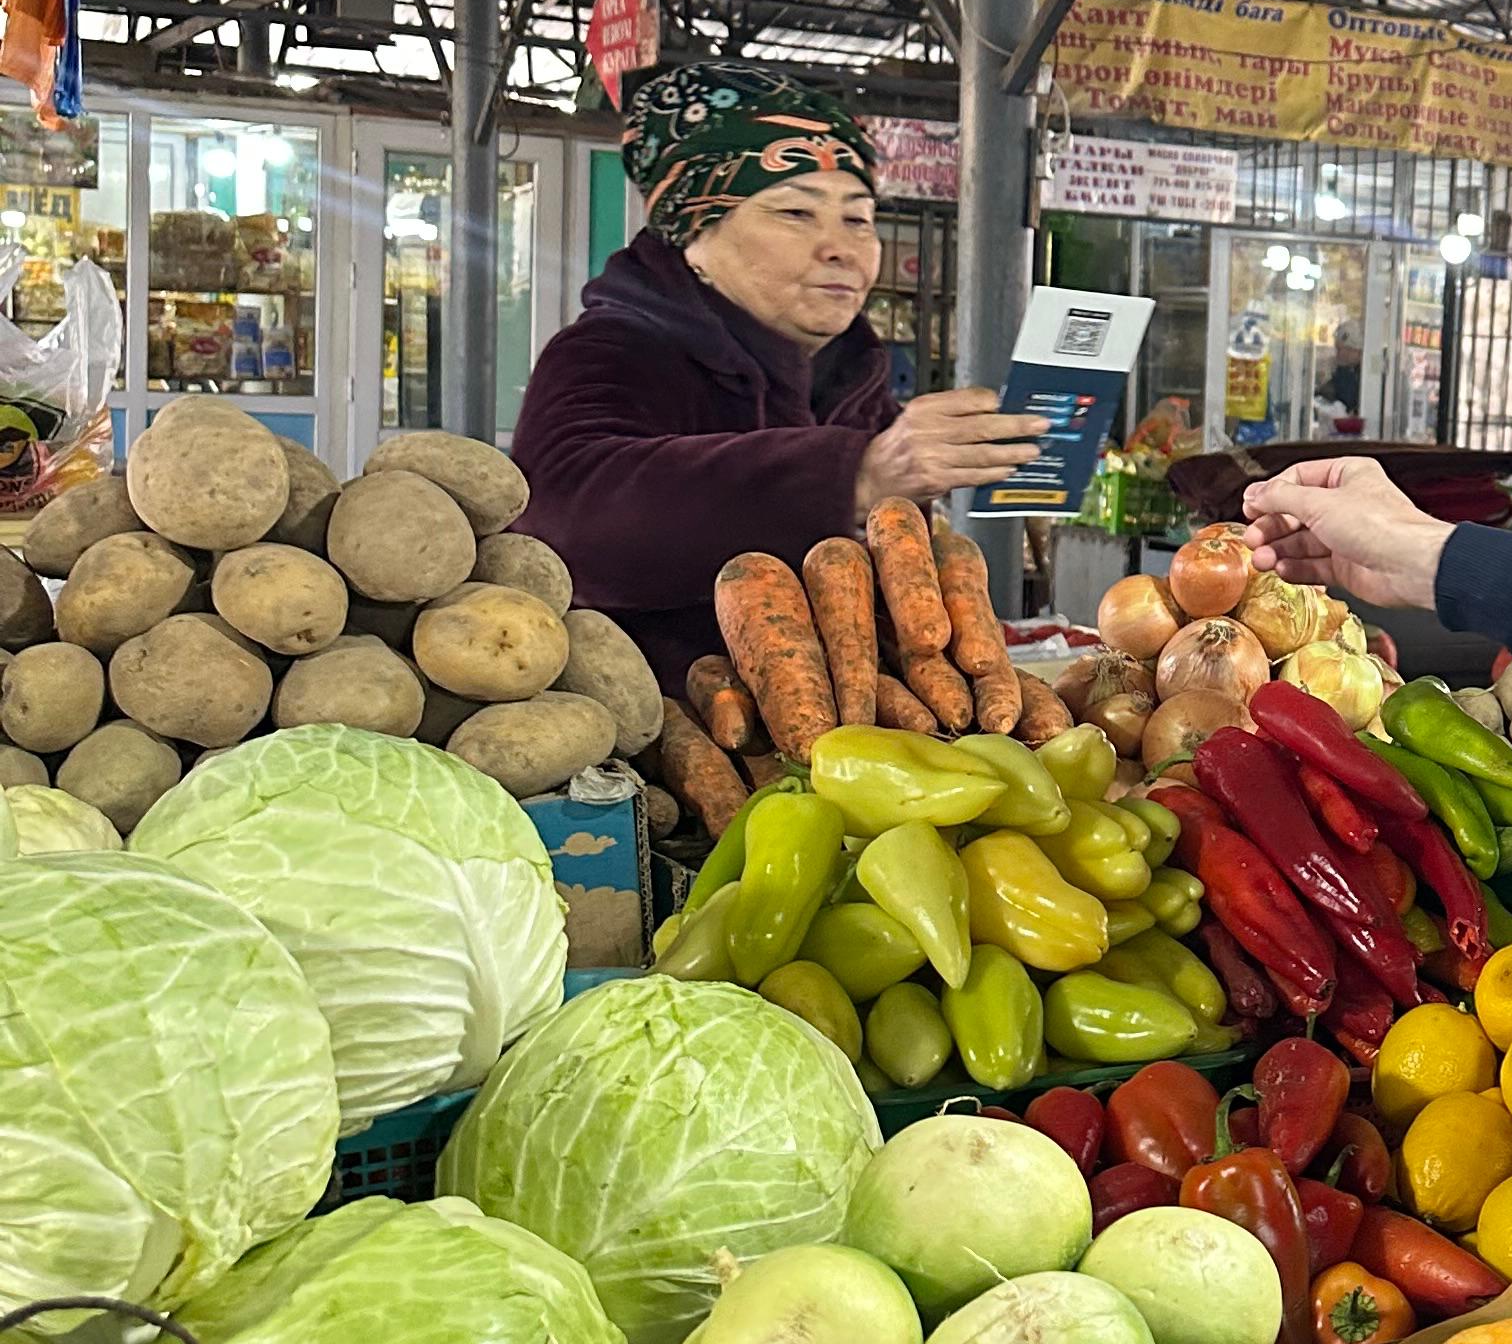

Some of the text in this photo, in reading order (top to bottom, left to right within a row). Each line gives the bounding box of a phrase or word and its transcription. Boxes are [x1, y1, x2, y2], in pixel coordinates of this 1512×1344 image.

[1327, 8, 1447, 42] Оптовые
[1328, 36, 1497, 86] Мука, Сахар
[1327, 64, 1420, 94] Крупы
[1431, 81, 1480, 105] всех
[1086, 86, 1278, 129] Томат, май
[1325, 92, 1469, 127] Макаронные
[1326, 116, 1398, 143] Соль,
[1074, 144, 1134, 160] ТАРЫ
